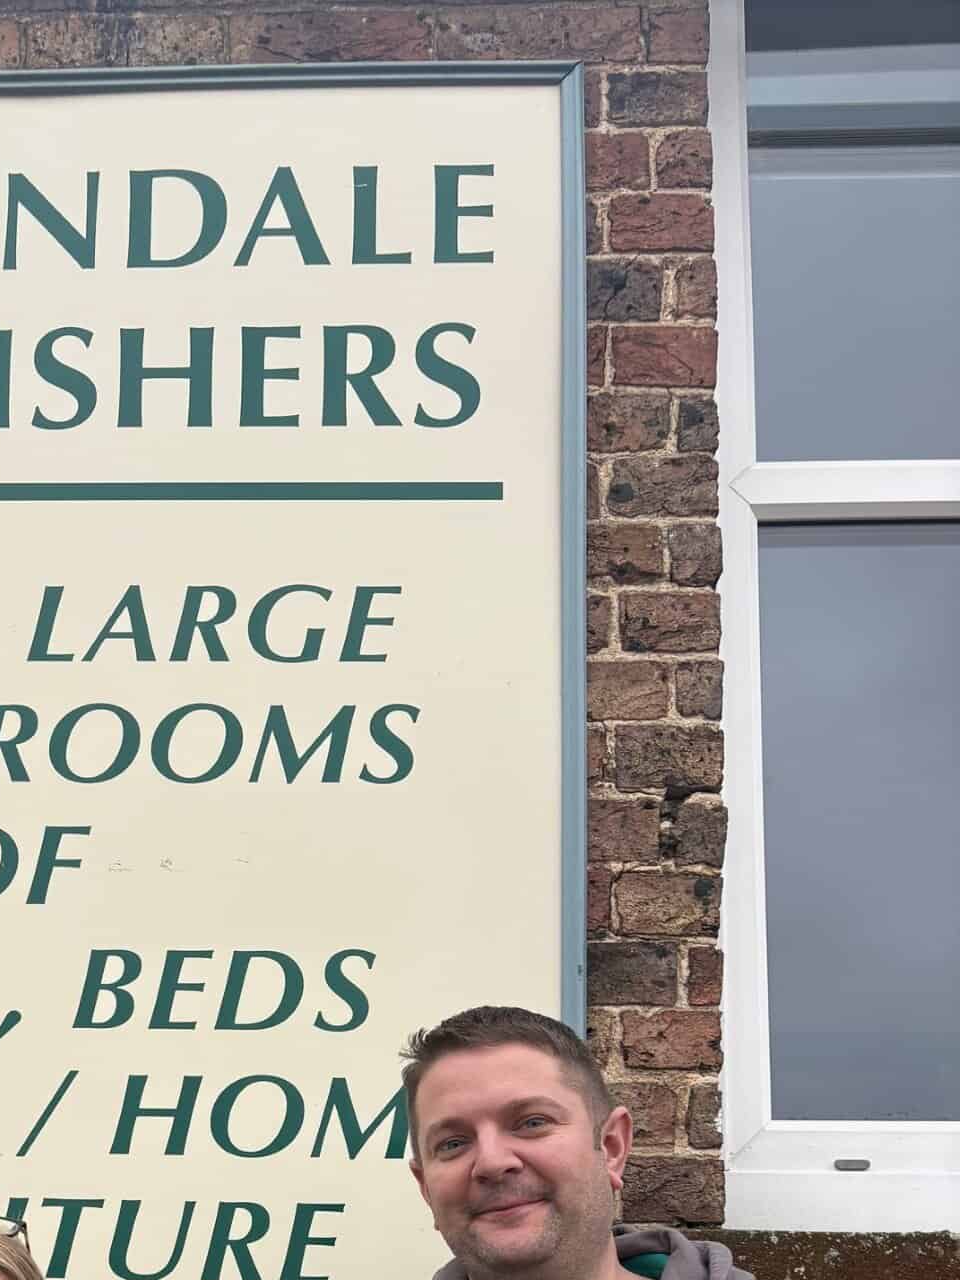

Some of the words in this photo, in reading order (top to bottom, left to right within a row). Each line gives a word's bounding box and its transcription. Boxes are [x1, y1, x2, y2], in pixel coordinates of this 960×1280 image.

[27, 585, 402, 663] LARGE
[72, 948, 377, 1033] BEDS
[15, 1070, 79, 1157] /
[110, 1074, 410, 1160] HOM
